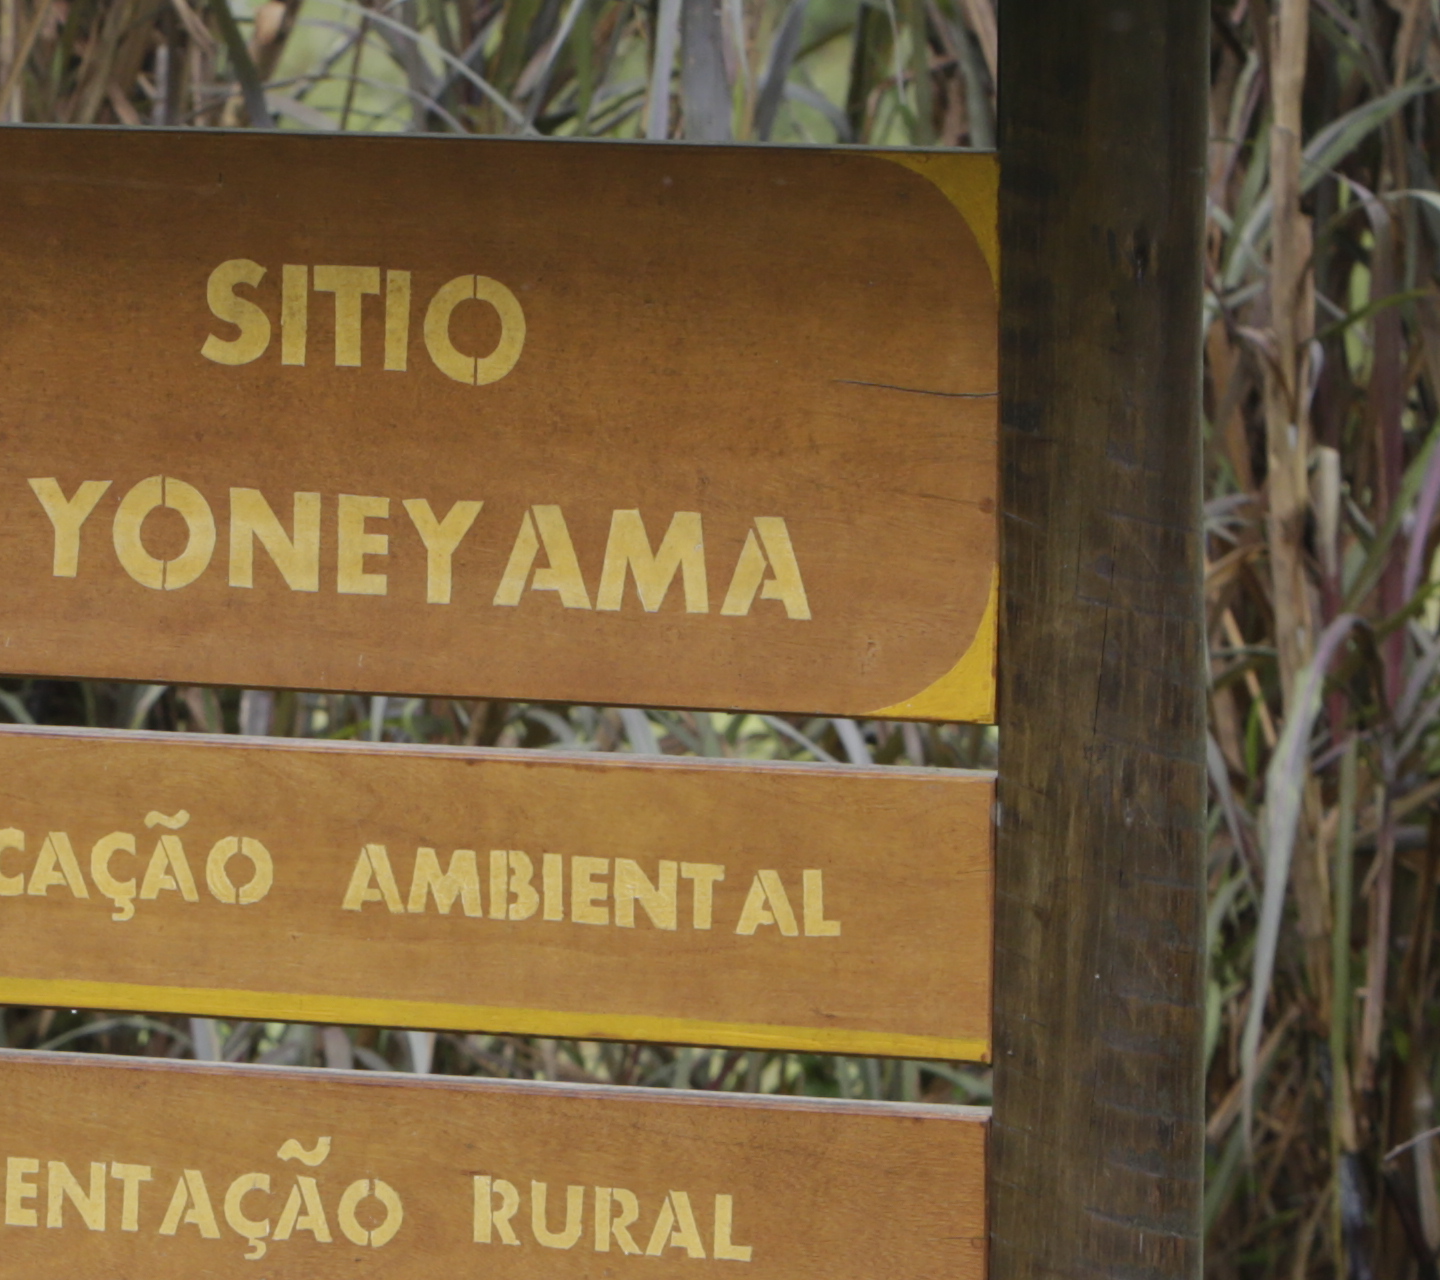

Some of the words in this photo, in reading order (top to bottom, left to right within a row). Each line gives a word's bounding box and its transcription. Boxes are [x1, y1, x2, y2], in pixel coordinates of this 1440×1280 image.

[201, 257, 527, 386] SITIO
[28, 475, 812, 620] YONEYAMA
[342, 843, 841, 937] AMBIENTAL
[473, 1175, 753, 1262] RURAL
